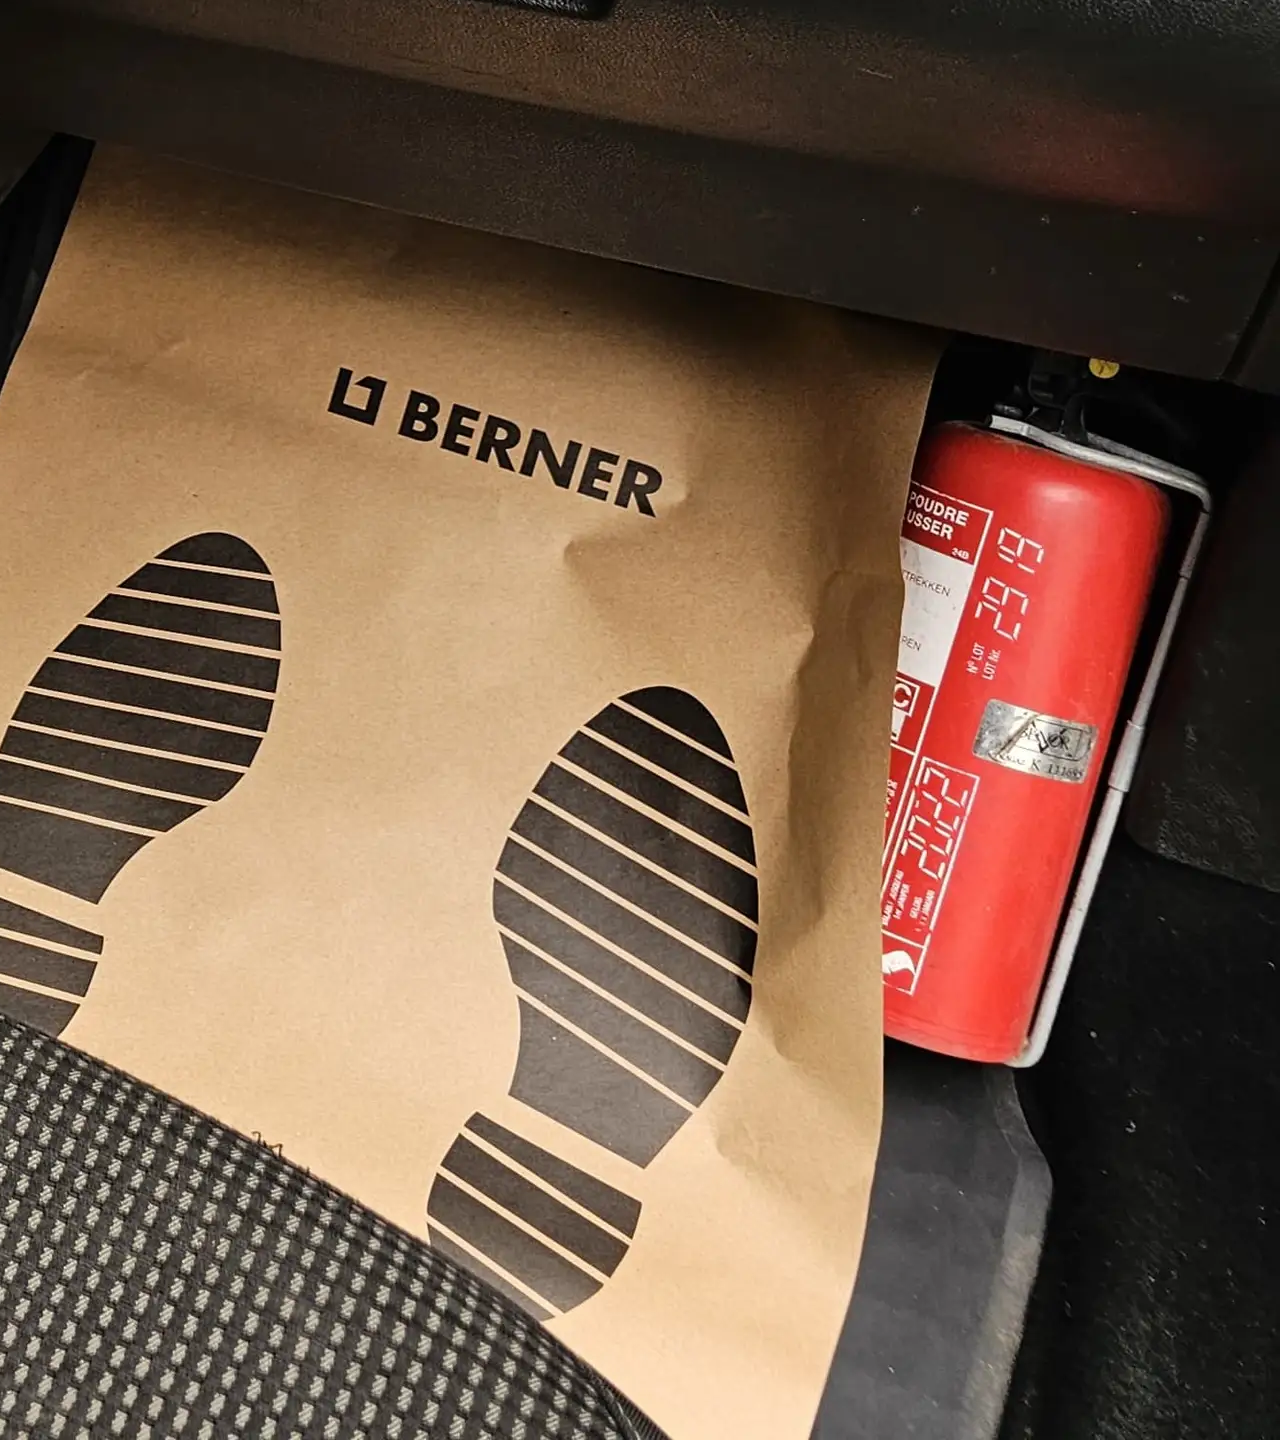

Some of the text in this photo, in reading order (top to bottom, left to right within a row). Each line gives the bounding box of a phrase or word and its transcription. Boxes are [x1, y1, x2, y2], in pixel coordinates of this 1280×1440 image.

[397, 389, 663, 519] BERNER
[910, 490, 970, 528] POUDRE
[904, 511, 955, 542] USSER
[970, 641, 985, 661] LOT
[981, 660, 997, 681] LOT
